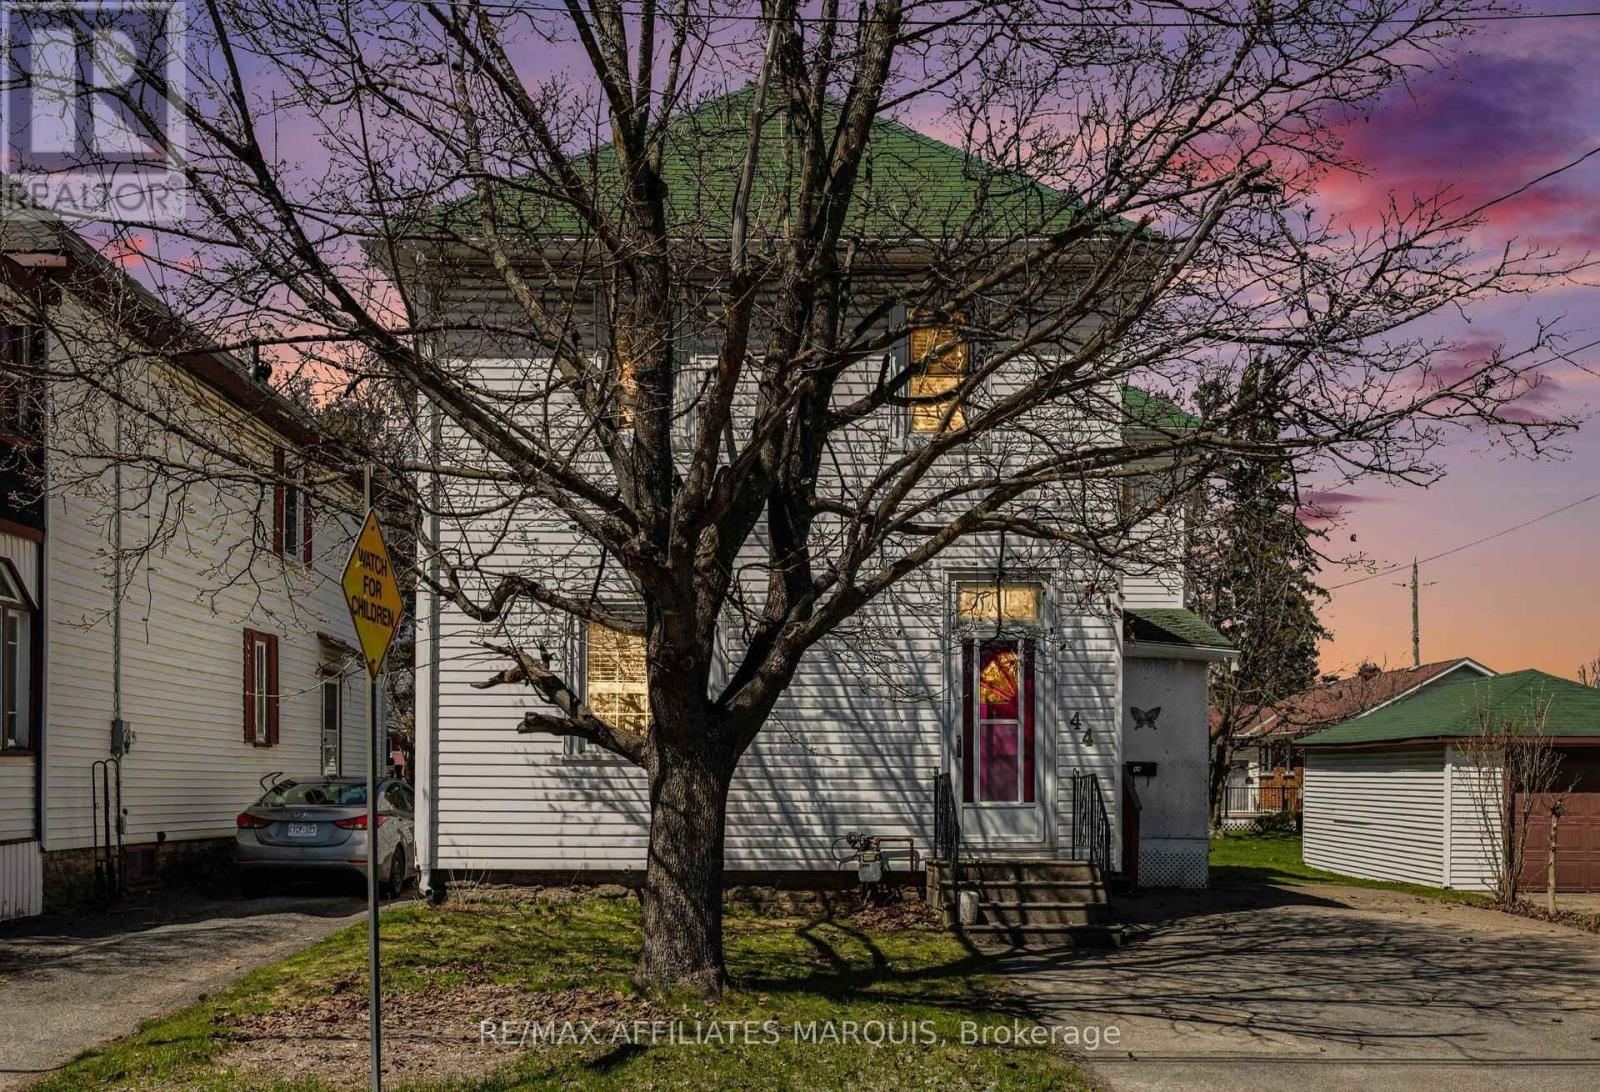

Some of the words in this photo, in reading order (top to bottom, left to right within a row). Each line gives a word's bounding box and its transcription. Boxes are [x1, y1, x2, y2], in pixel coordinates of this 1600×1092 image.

[358, 548, 388, 577] WATCH
[363, 575, 382, 600] FOR
[350, 595, 395, 628] CHILDREN
